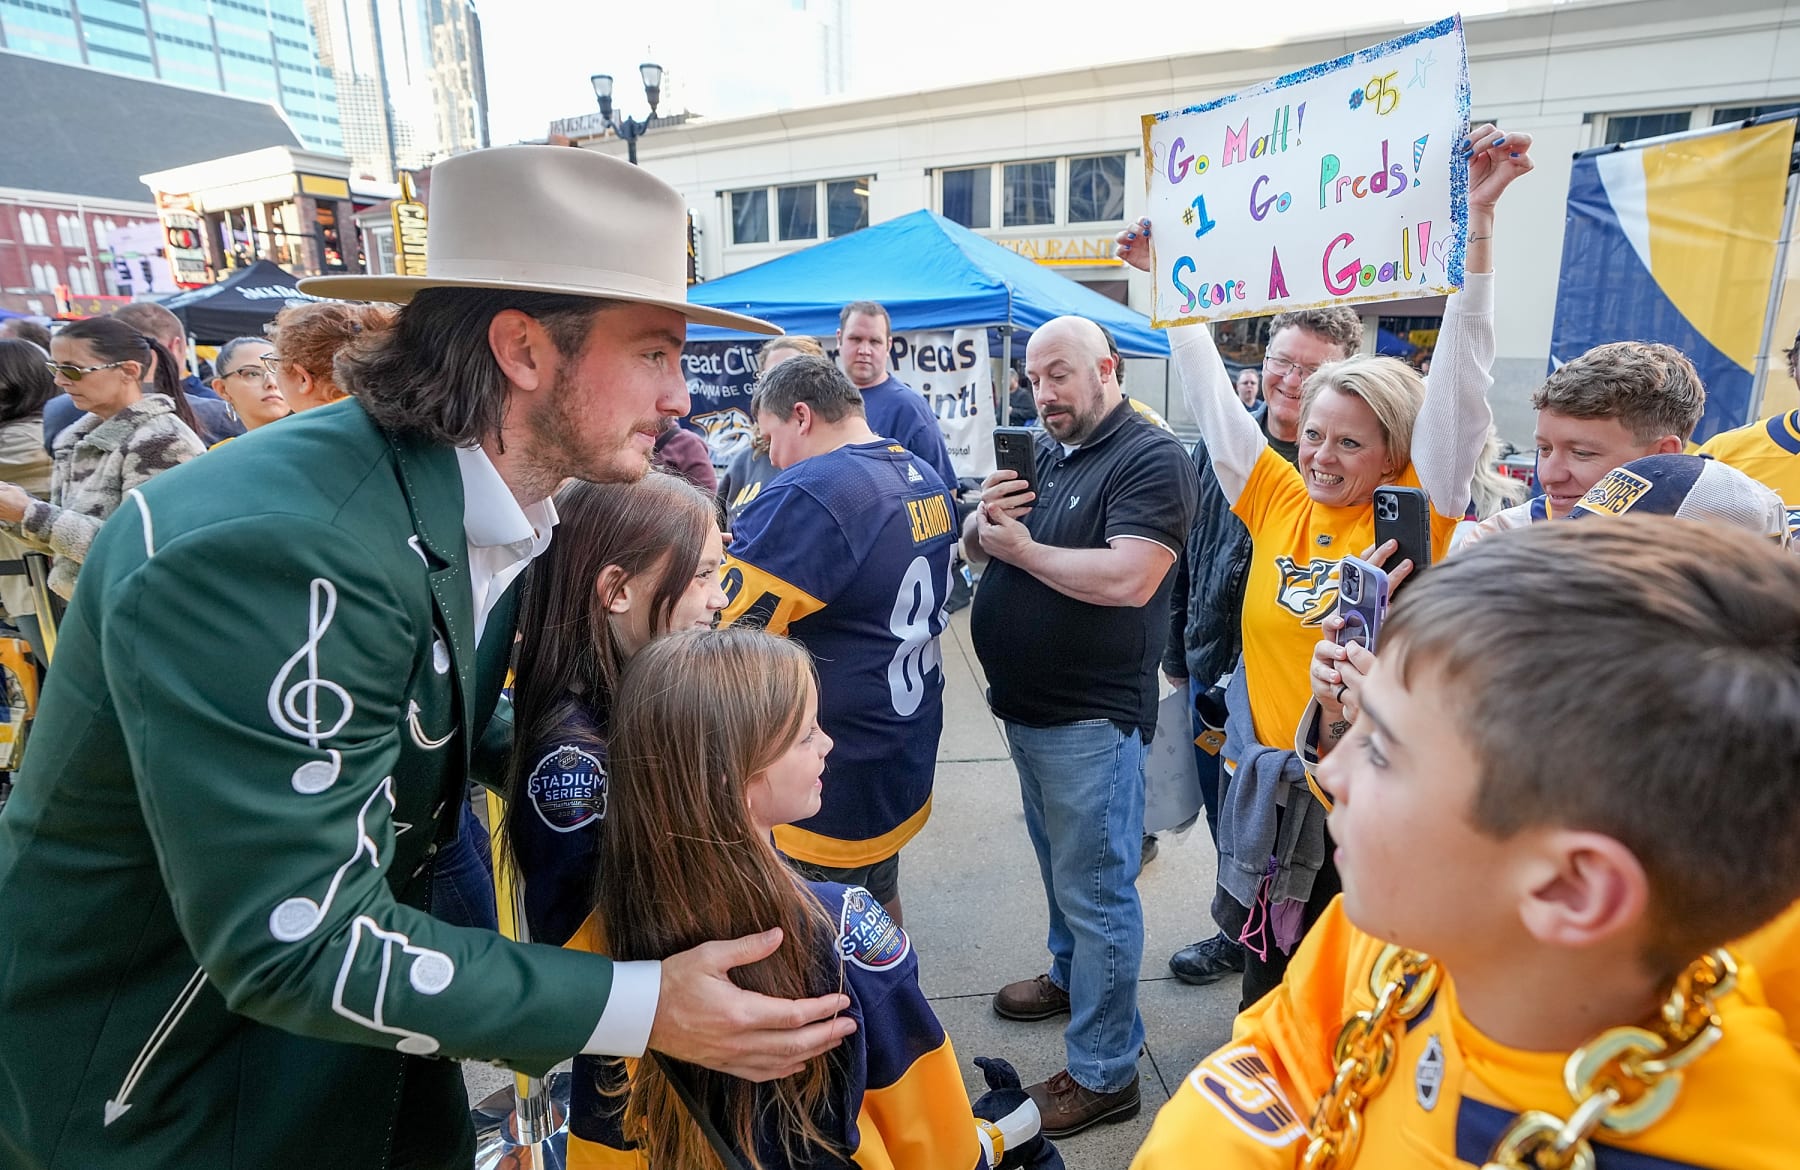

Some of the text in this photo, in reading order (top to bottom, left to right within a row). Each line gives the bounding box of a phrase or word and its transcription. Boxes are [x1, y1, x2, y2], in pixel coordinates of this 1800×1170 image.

[1168, 71, 1399, 184] Go Matt! #95
[1183, 193, 1216, 239] #1
[1250, 175, 1292, 221] Go
[1172, 221, 1432, 313] Score A Goal!
[722, 385, 741, 398] BE
[906, 494, 952, 543] JEANNOT
[531, 773, 606, 794] STADIUM
[545, 787, 592, 801] SERIES
